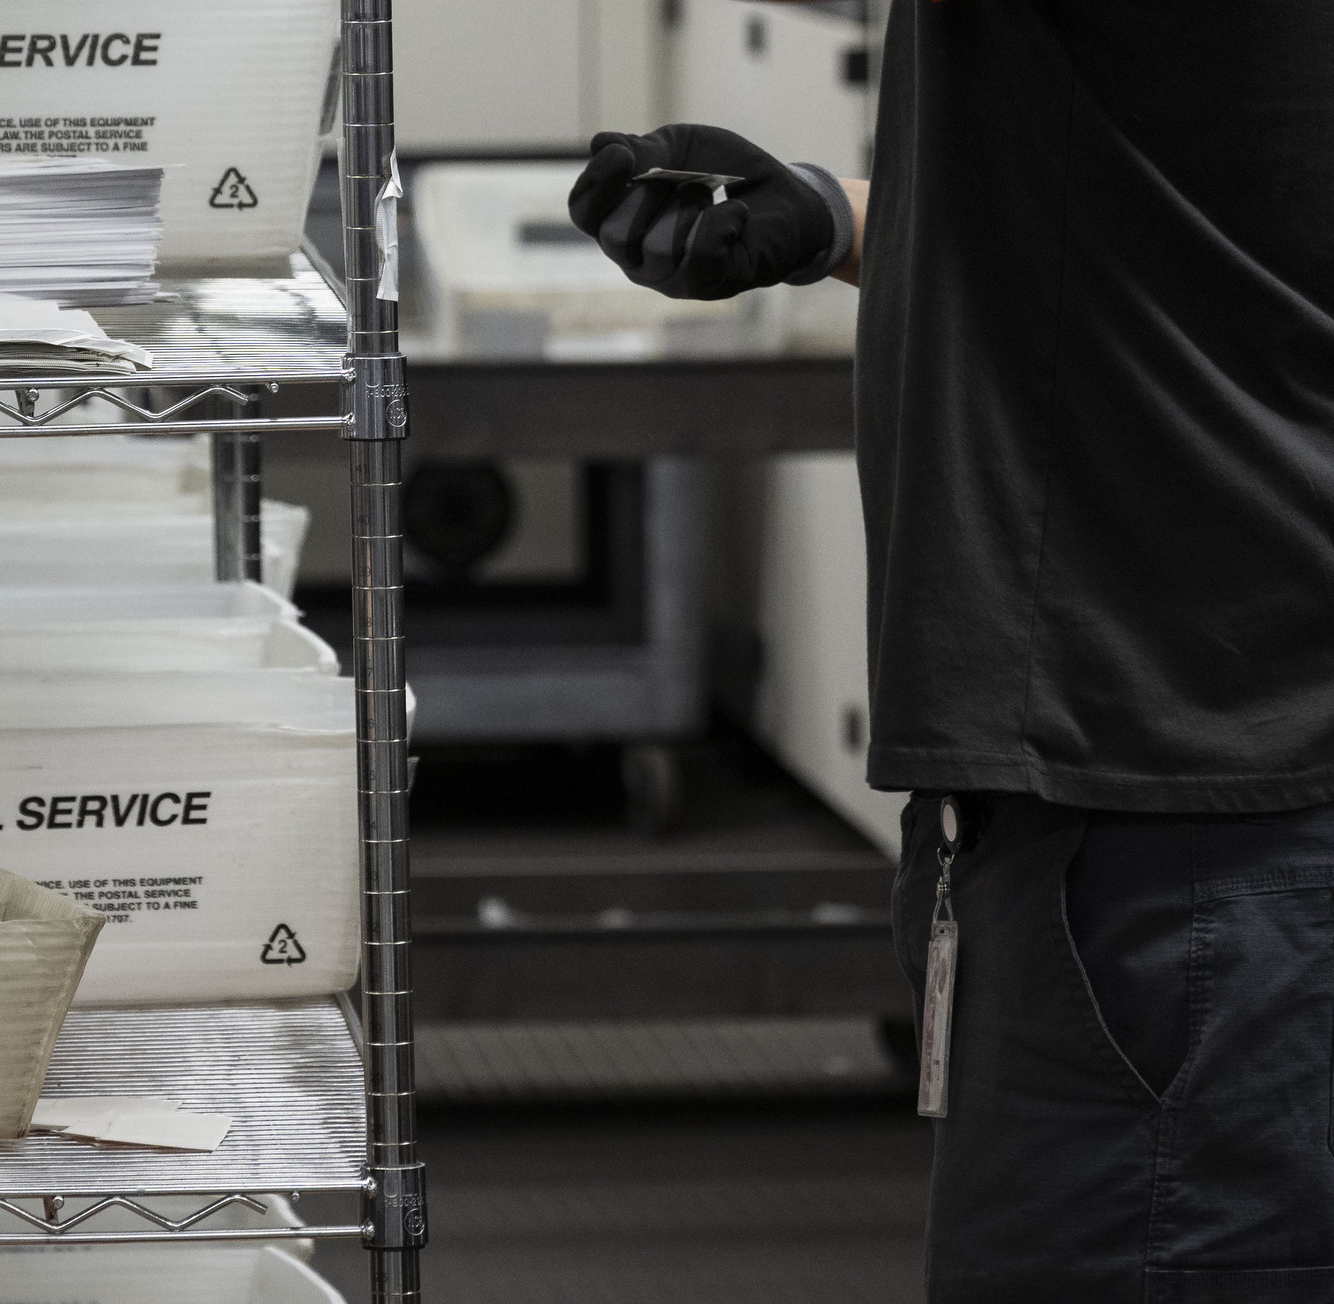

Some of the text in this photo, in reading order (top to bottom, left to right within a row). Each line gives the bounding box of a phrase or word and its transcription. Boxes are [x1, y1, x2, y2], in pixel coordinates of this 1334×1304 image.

[19, 118, 42, 128] USE
[44, 118, 60, 128] OF
[62, 117, 87, 127] THIS
[90, 117, 155, 127] EQUIPMENT
[23, 130, 45, 140] THE
[48, 130, 91, 140] POSTAL
[94, 129, 143, 139] SERVICE
[14, 142, 38, 152] ARE
[40, 142, 91, 152] SUBJECT
[94, 142, 108, 152] TO
[112, 141, 120, 151] A
[122, 141, 148, 151] FINE
[16, 791, 212, 830] SERVICE
[68, 879, 90, 889] USE
[94, 879, 108, 888] OF
[112, 878, 136, 887] THIS
[139, 876, 203, 887] EQUIPMENT
[74, 891, 94, 900] THE
[98, 890, 140, 899] POSTAL
[144, 889, 191, 898] SERVICE
[92, 900, 198, 912] SUBJECT TO A FINE
[277, 939, 288, 954] 2
